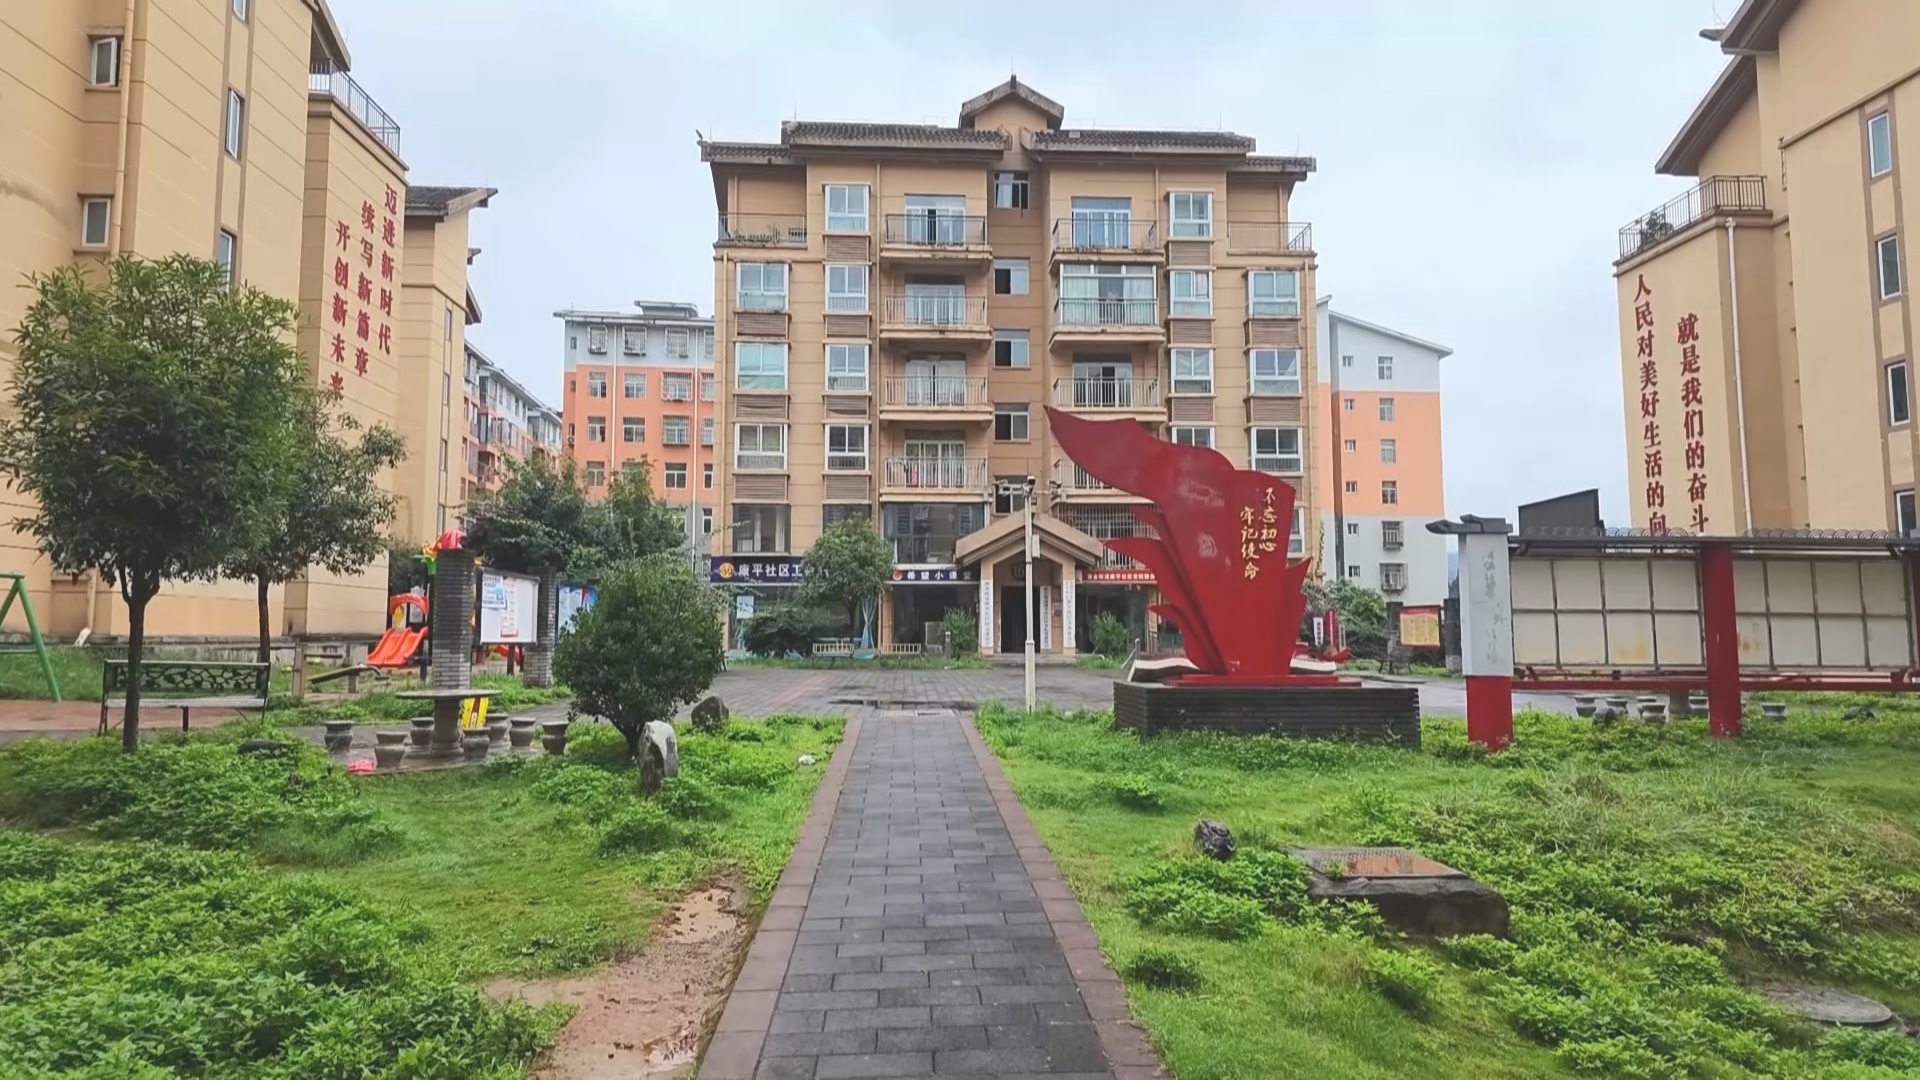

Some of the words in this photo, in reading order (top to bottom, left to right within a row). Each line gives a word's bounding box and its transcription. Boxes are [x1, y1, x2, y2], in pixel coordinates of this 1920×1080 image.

[330, 220, 350, 400] 开创新未来
[354, 200, 376, 377] 续写新篇章
[378, 183, 398, 355] 迈进新时代
[1634, 273, 1667, 536] 人民对美好生活的向
[1677, 313, 1709, 533] 就是我们的奋斗
[739, 563, 815, 577] 康平社区工
[1240, 506, 1260, 580] 牢记使命
[1259, 487, 1278, 552] 不忘初心
